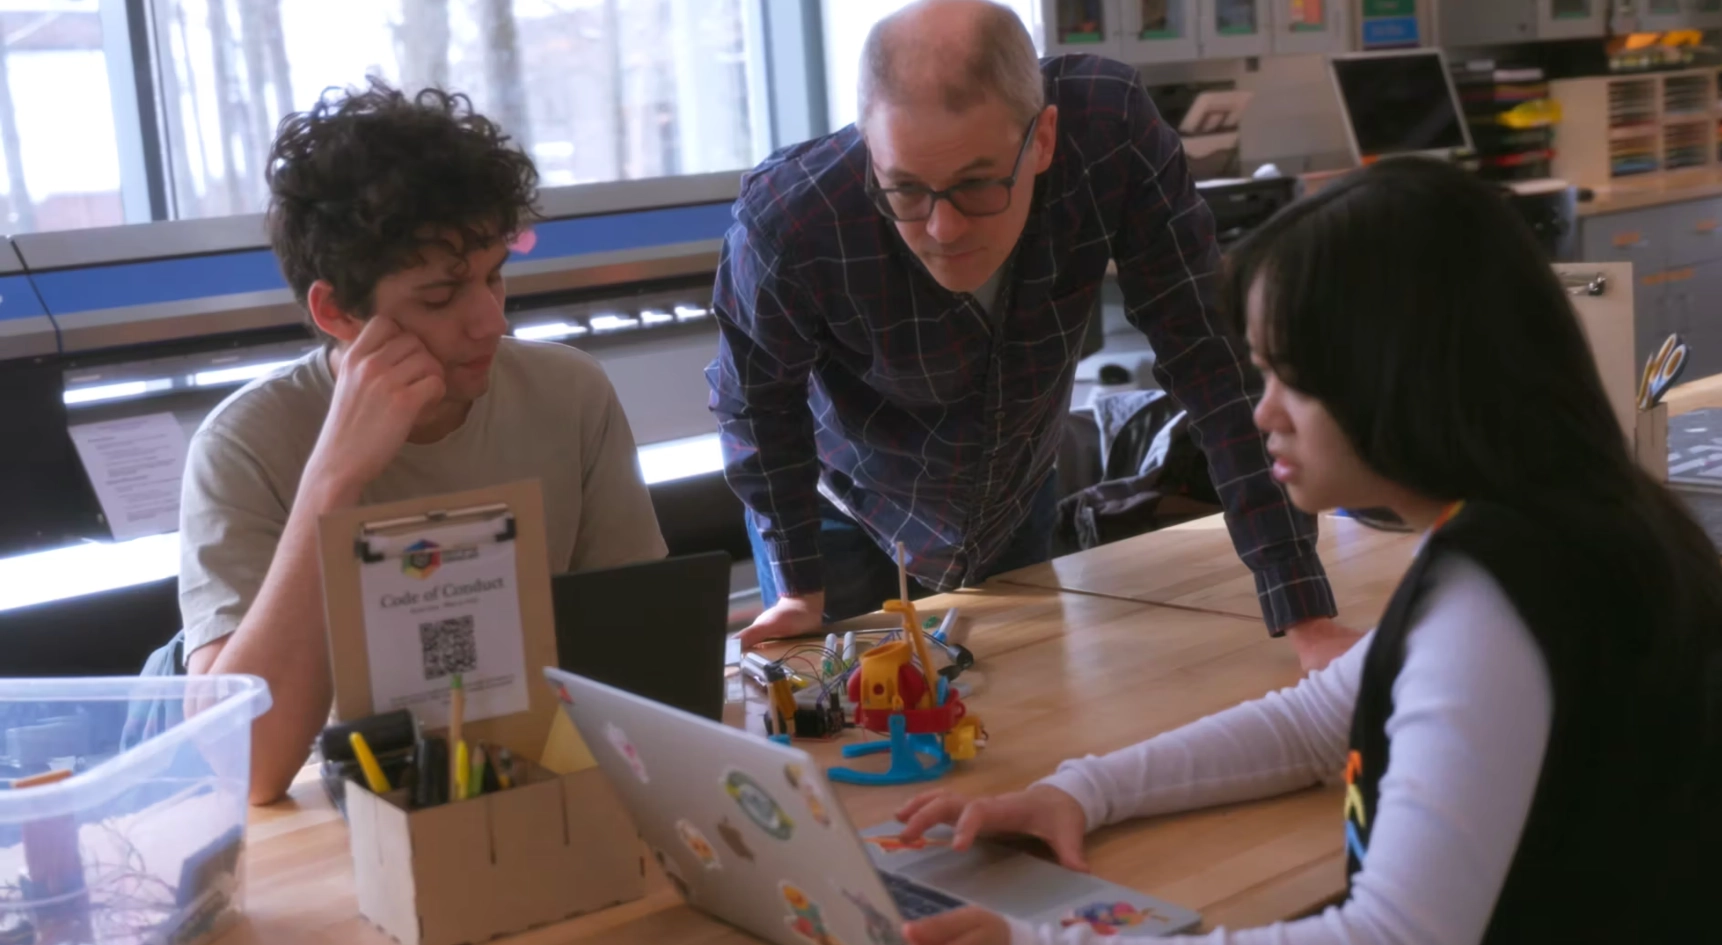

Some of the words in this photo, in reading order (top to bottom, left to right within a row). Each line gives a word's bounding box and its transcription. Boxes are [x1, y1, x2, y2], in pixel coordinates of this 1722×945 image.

[380, 591, 418, 608] Code
[423, 585, 439, 602] of
[442, 578, 504, 598] Conduct
